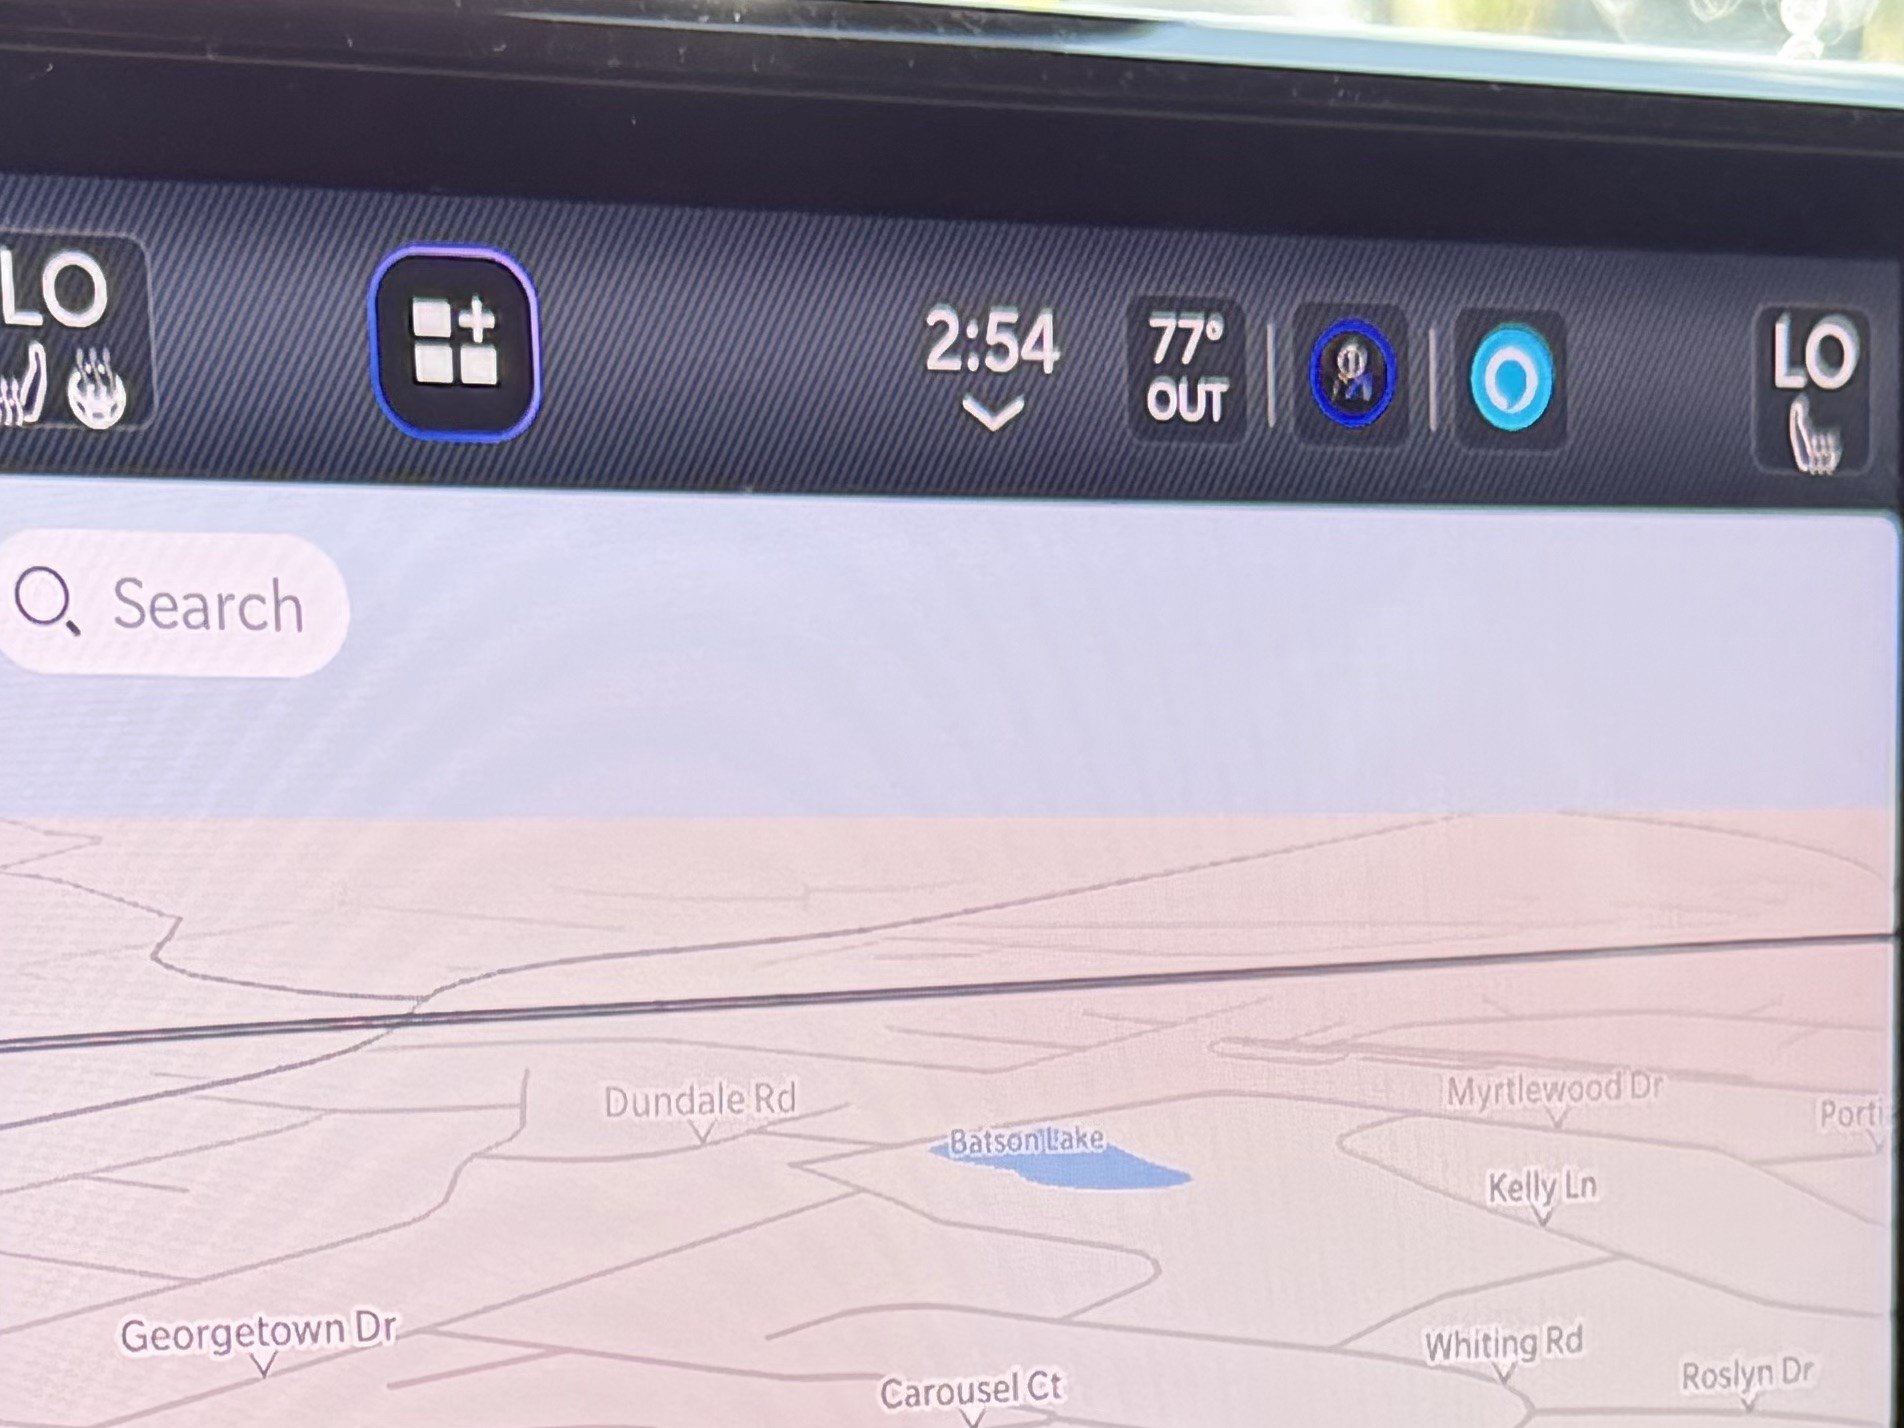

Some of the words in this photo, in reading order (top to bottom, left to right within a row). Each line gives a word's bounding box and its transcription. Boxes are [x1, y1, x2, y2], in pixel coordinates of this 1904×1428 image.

[0, 246, 108, 328] LO
[924, 302, 1062, 376] 2:54
[1148, 311, 1224, 366] 77°
[1773, 310, 1860, 390] LO
[1148, 376, 1230, 424] OUT
[113, 577, 305, 635] Search
[604, 1083, 746, 1119] Dundale
[755, 1080, 798, 1113] Rd
[1446, 1071, 1623, 1113] Myrtlewood
[1629, 1069, 1665, 1100] Dr
[949, 1127, 1038, 1153] Batson
[1044, 1125, 1105, 1150] Lake
[1489, 1172, 1559, 1205] Kelly
[1564, 1169, 1597, 1199] Ln
[119, 1314, 346, 1356] Georgetown
[354, 1311, 397, 1345] Dr
[1425, 1329, 1537, 1362] Whiting
[1545, 1324, 1584, 1355] Rd
[880, 1372, 1017, 1409] Carousel
[1026, 1370, 1063, 1400] Ct
[1682, 1360, 1773, 1393] Roslyn
[1779, 1357, 1814, 1385] Dr
